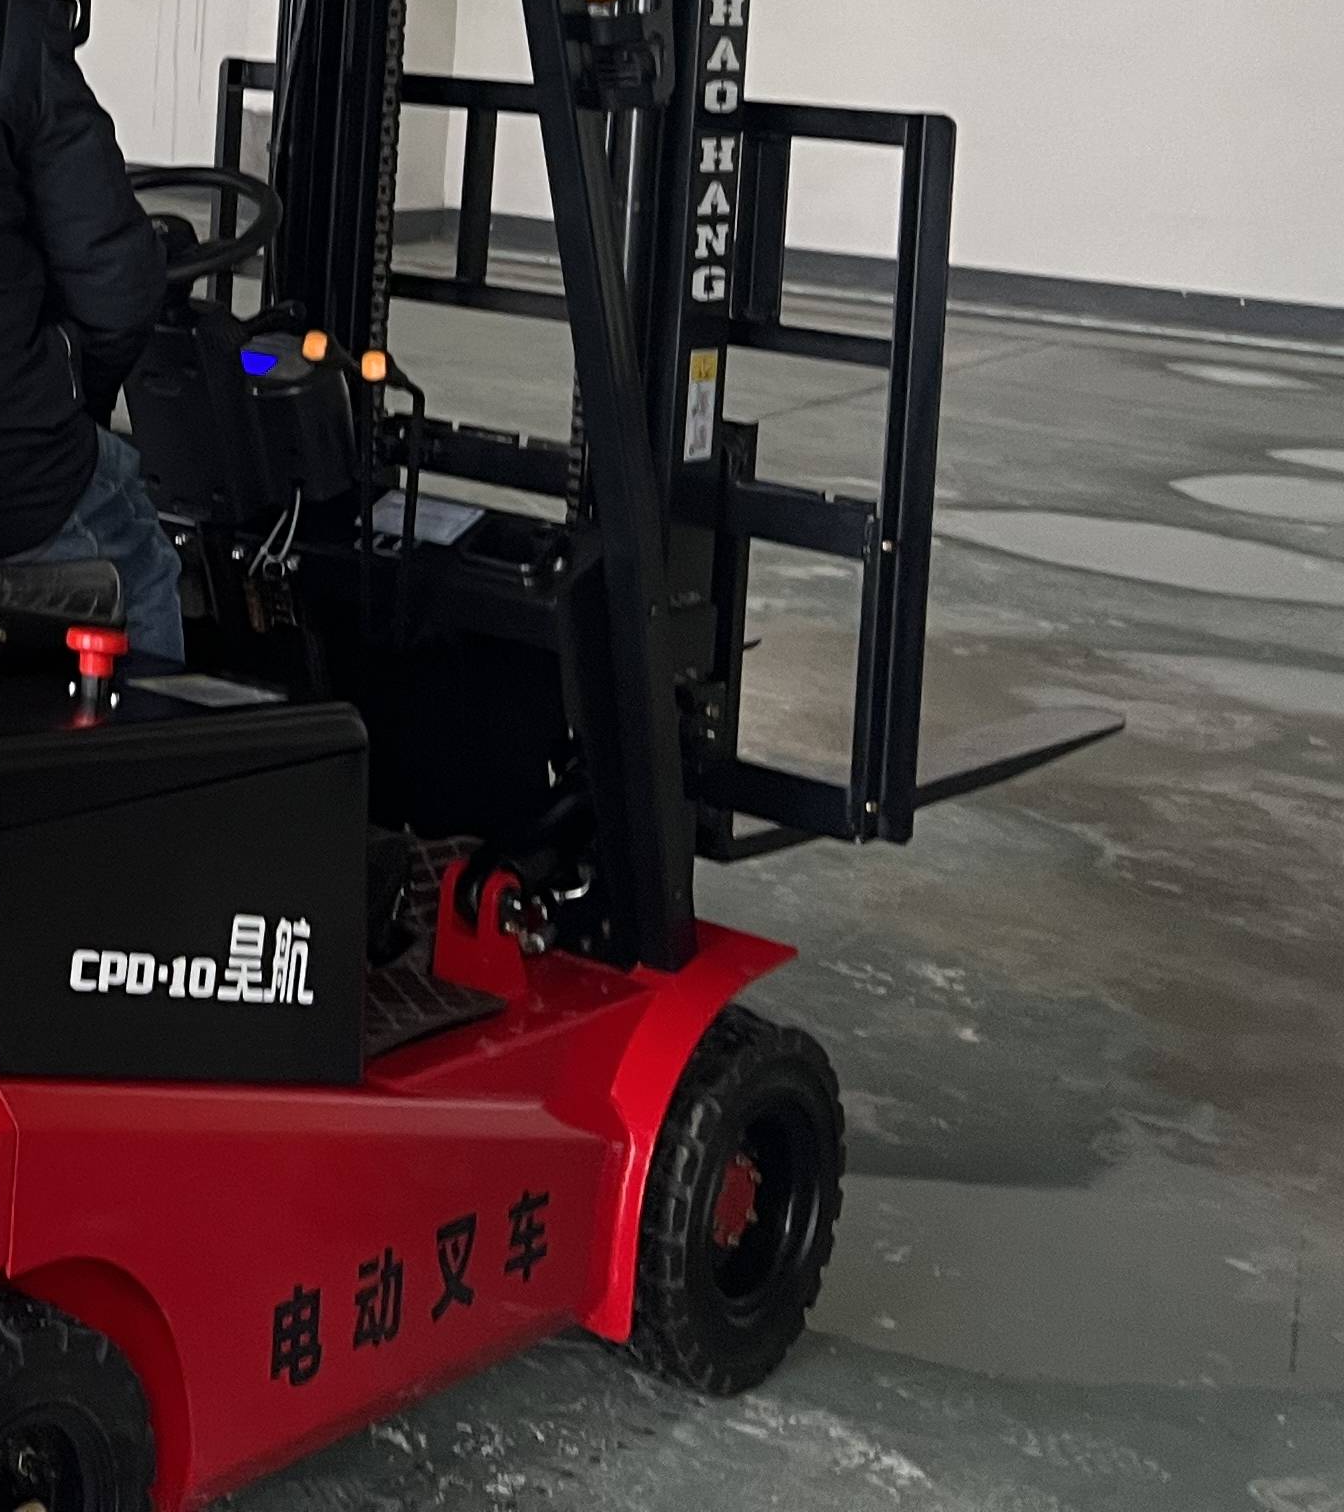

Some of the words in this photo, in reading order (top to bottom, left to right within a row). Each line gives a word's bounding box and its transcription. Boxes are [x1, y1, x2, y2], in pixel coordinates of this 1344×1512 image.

[691, 136, 736, 303] HANG
[270, 1190, 550, 1386] 电动叉车
